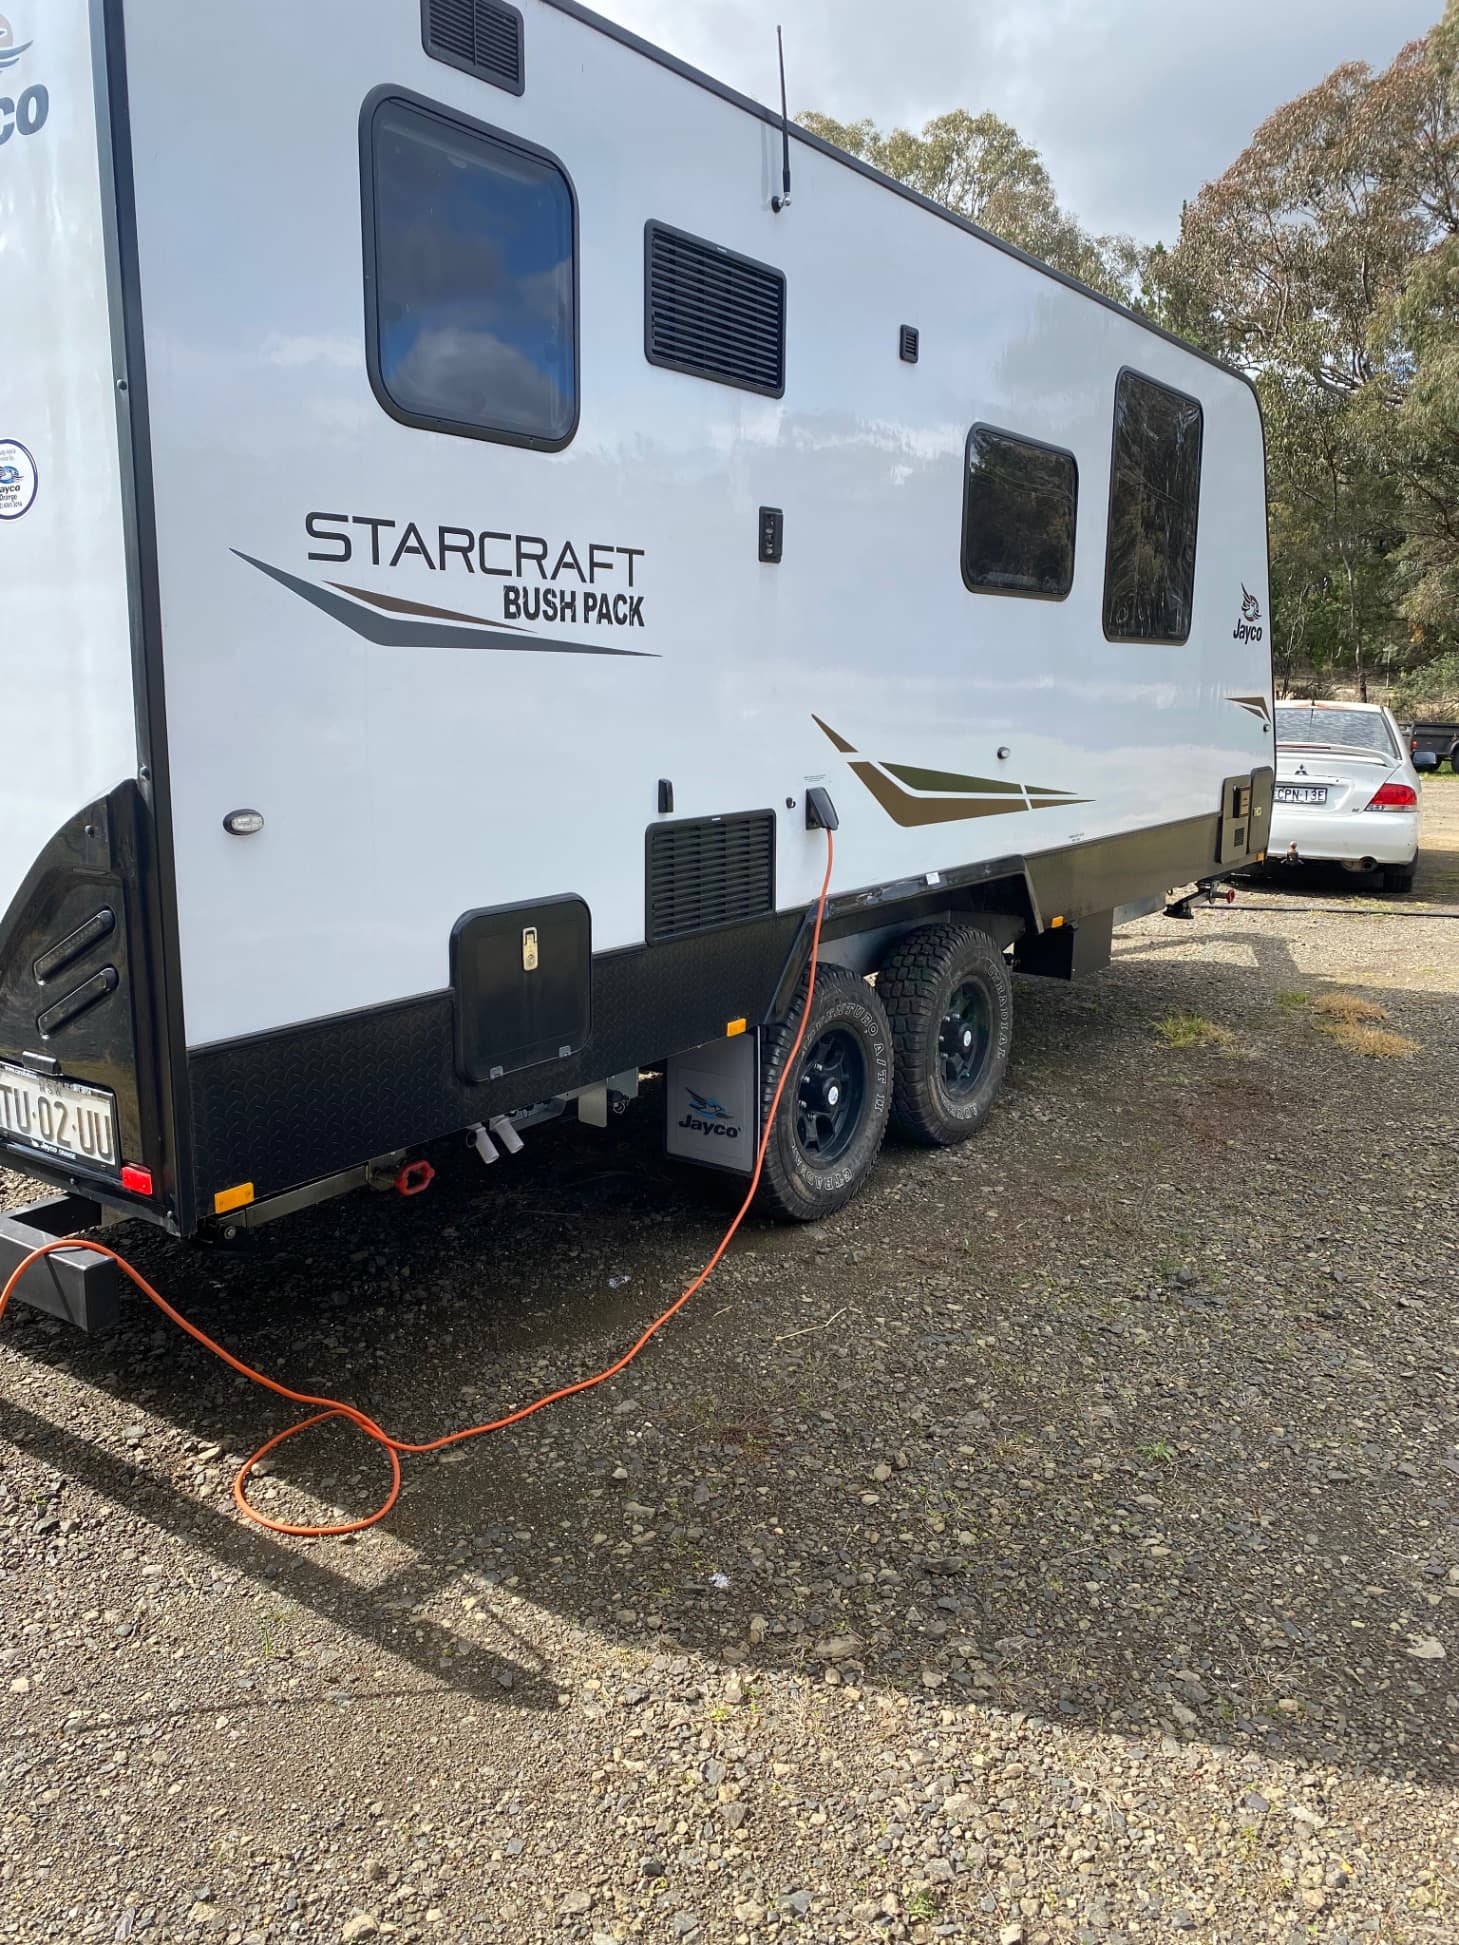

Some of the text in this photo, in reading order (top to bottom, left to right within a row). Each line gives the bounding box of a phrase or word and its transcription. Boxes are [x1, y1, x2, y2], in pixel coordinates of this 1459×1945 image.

[305, 511, 646, 588] STARCRAFT
[503, 585, 646, 628] BUSH PACK
[1233, 618, 1263, 645] Jayco
[678, 1114, 739, 1138] Jayco
